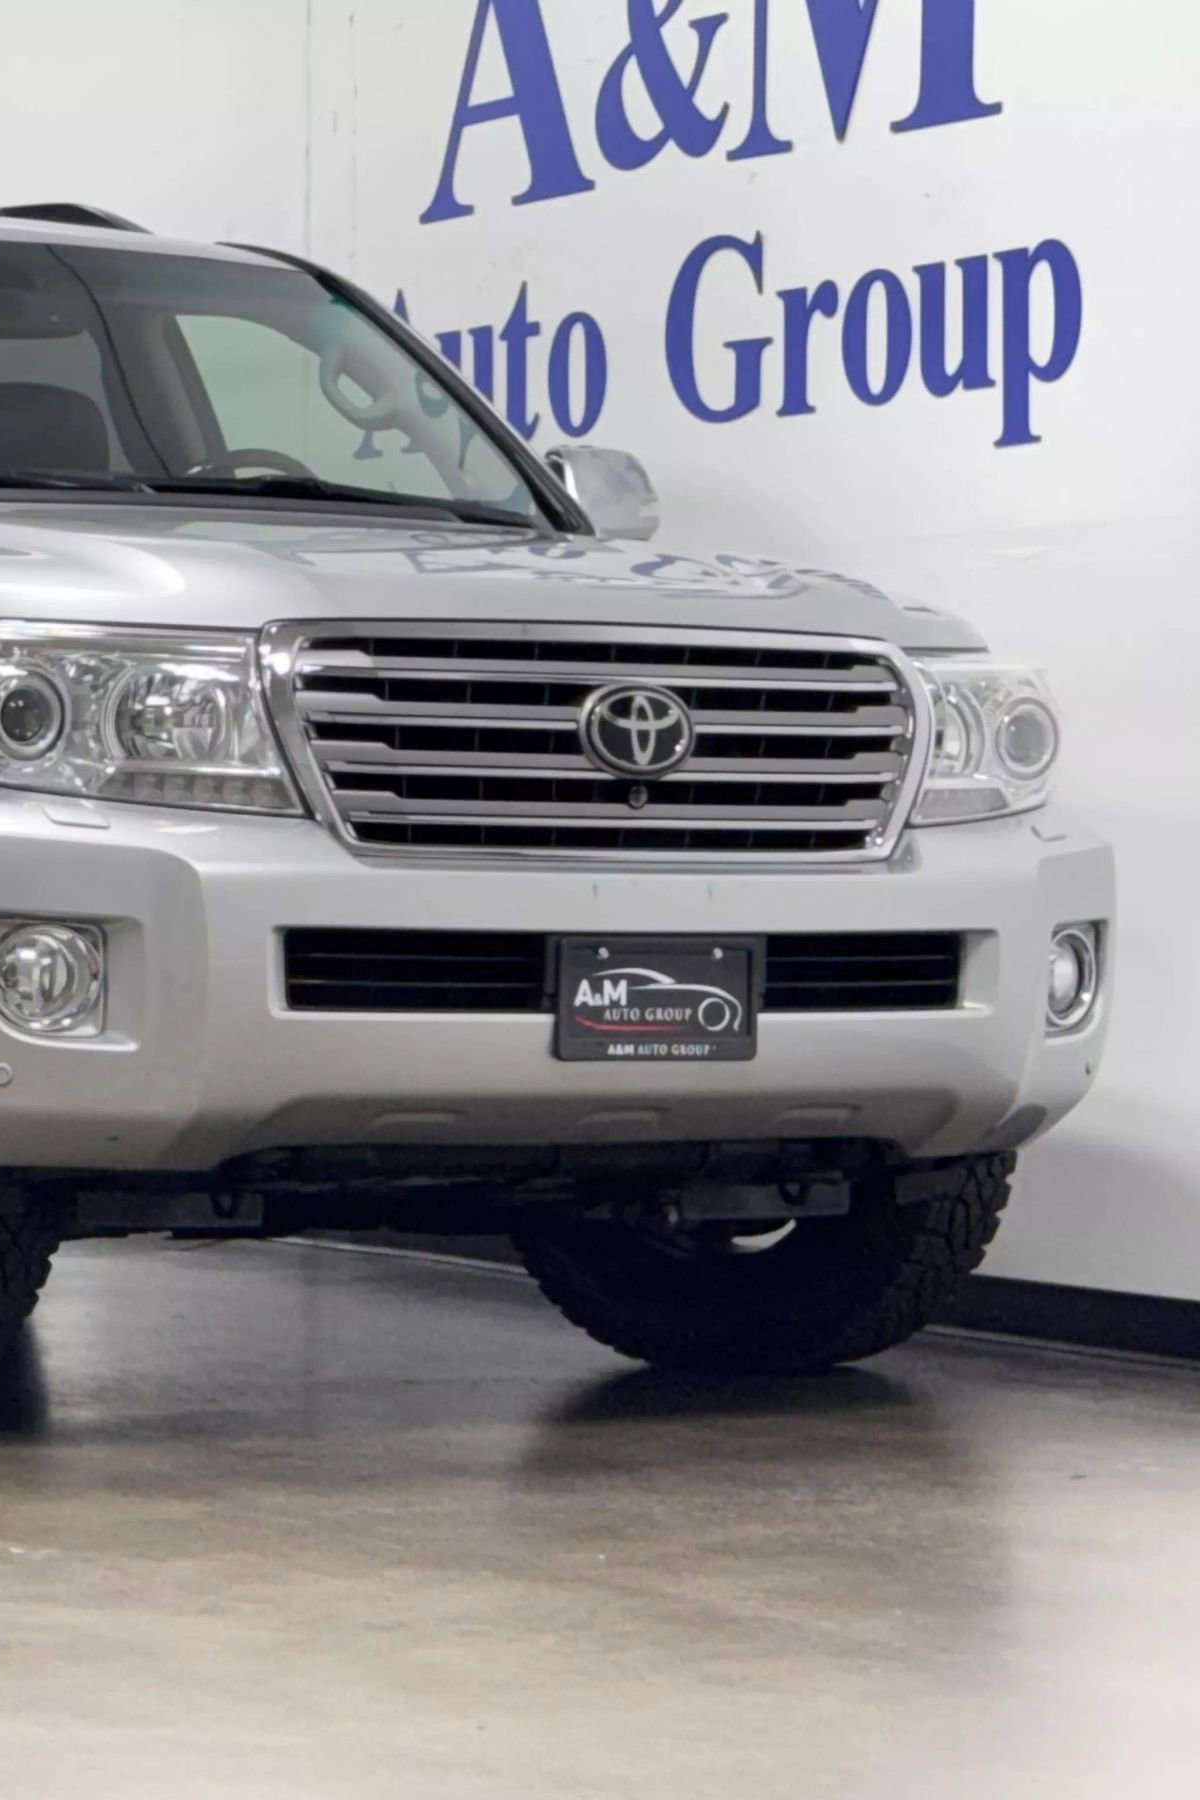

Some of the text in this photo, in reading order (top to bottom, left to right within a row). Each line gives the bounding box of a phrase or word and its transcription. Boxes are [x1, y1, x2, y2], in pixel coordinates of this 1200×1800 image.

[664, 230, 1082, 449] Group
[574, 978, 628, 1007] A&M
[603, 1007, 693, 1021] AUTO GROUP
[607, 1043, 710, 1056] A&M AUTO GROUP
